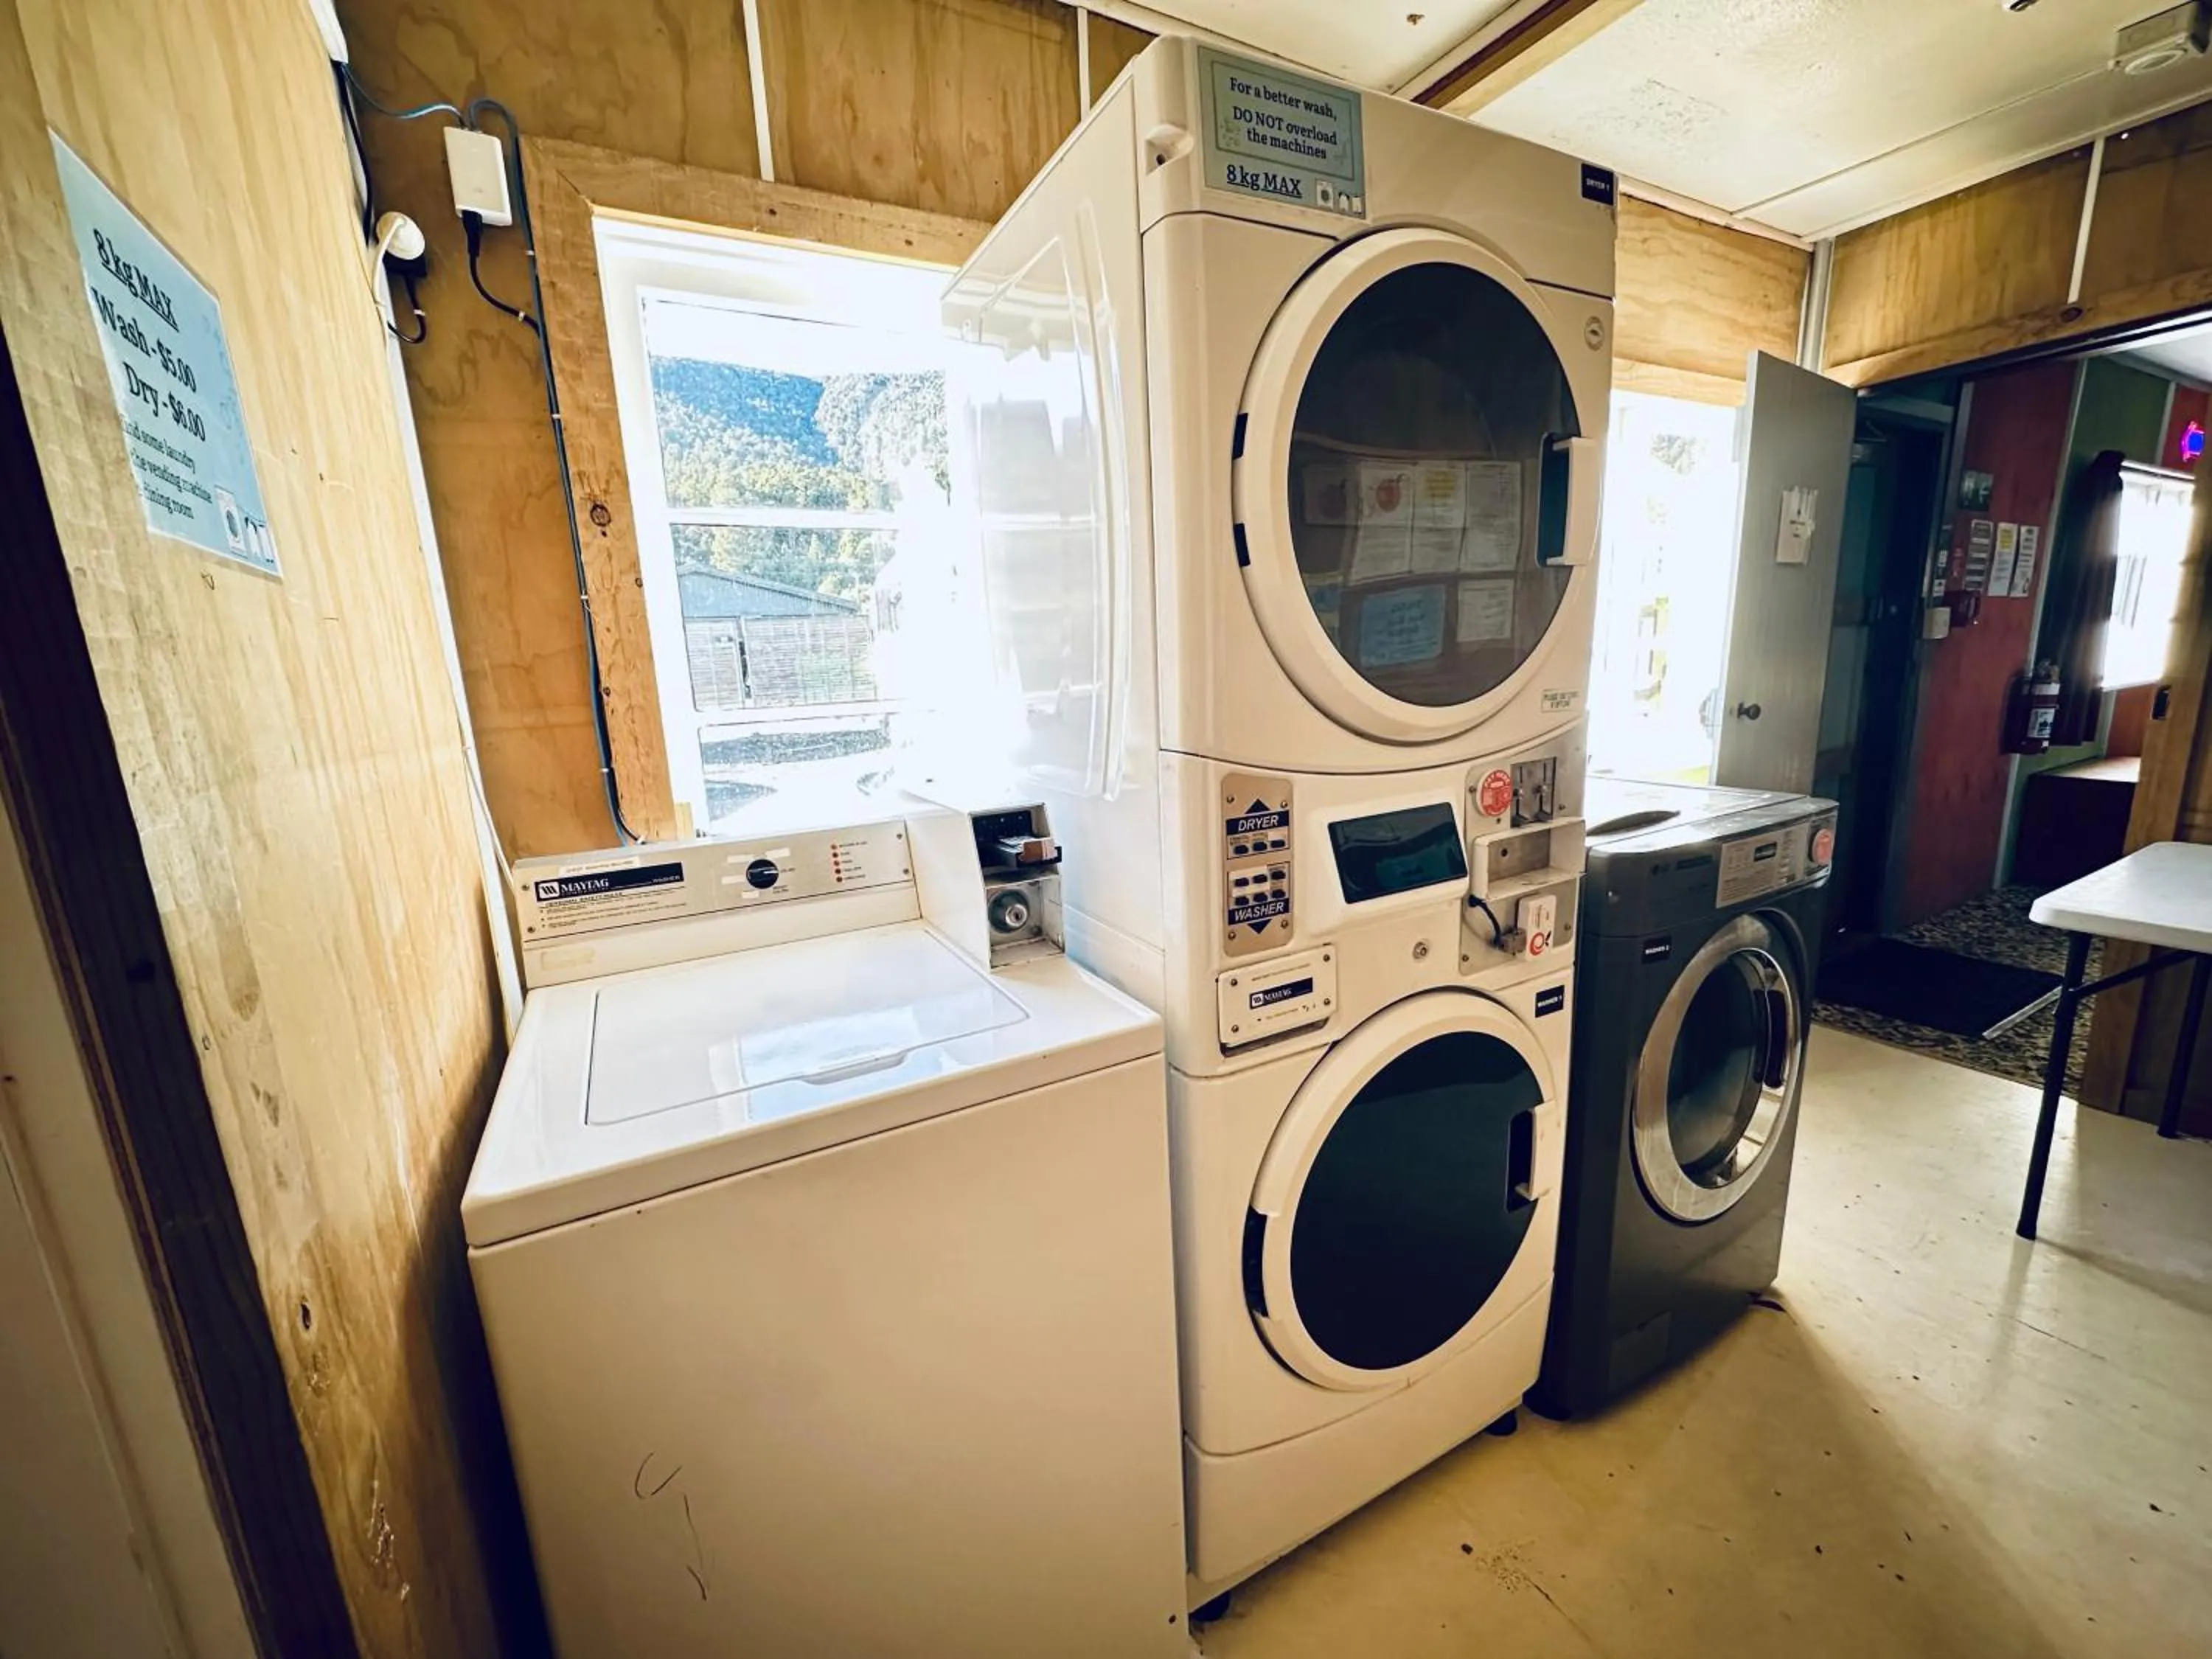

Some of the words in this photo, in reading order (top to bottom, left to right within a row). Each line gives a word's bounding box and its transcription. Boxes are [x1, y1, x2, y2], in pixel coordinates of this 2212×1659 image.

[1230, 77, 1252, 95] For
[1254, 87, 1262, 98] a
[1263, 85, 1301, 108] better
[1303, 100, 1337, 122] wash,
[1233, 105, 1253, 123] DO
[1255, 111, 1284, 131] NOT
[1285, 122, 1338, 145] overload
[1247, 128, 1267, 145] the
[1270, 136, 1326, 159] machines
[1227, 164, 1237, 182] 8
[1239, 165, 1260, 190] kg
[1262, 172, 1303, 197] MAX
[94, 229, 110, 265] 8
[106, 237, 139, 299] kg
[133, 265, 179, 330] MAX
[91, 286, 151, 358] Wash
[157, 337, 197, 393] $5.00
[123, 361, 159, 417] Dry
[168, 391, 206, 442] $6.00
[1238, 815, 1280, 832] DRYER
[561, 878, 609, 892] MAYTAG
[1235, 901, 1284, 922] WASHER
